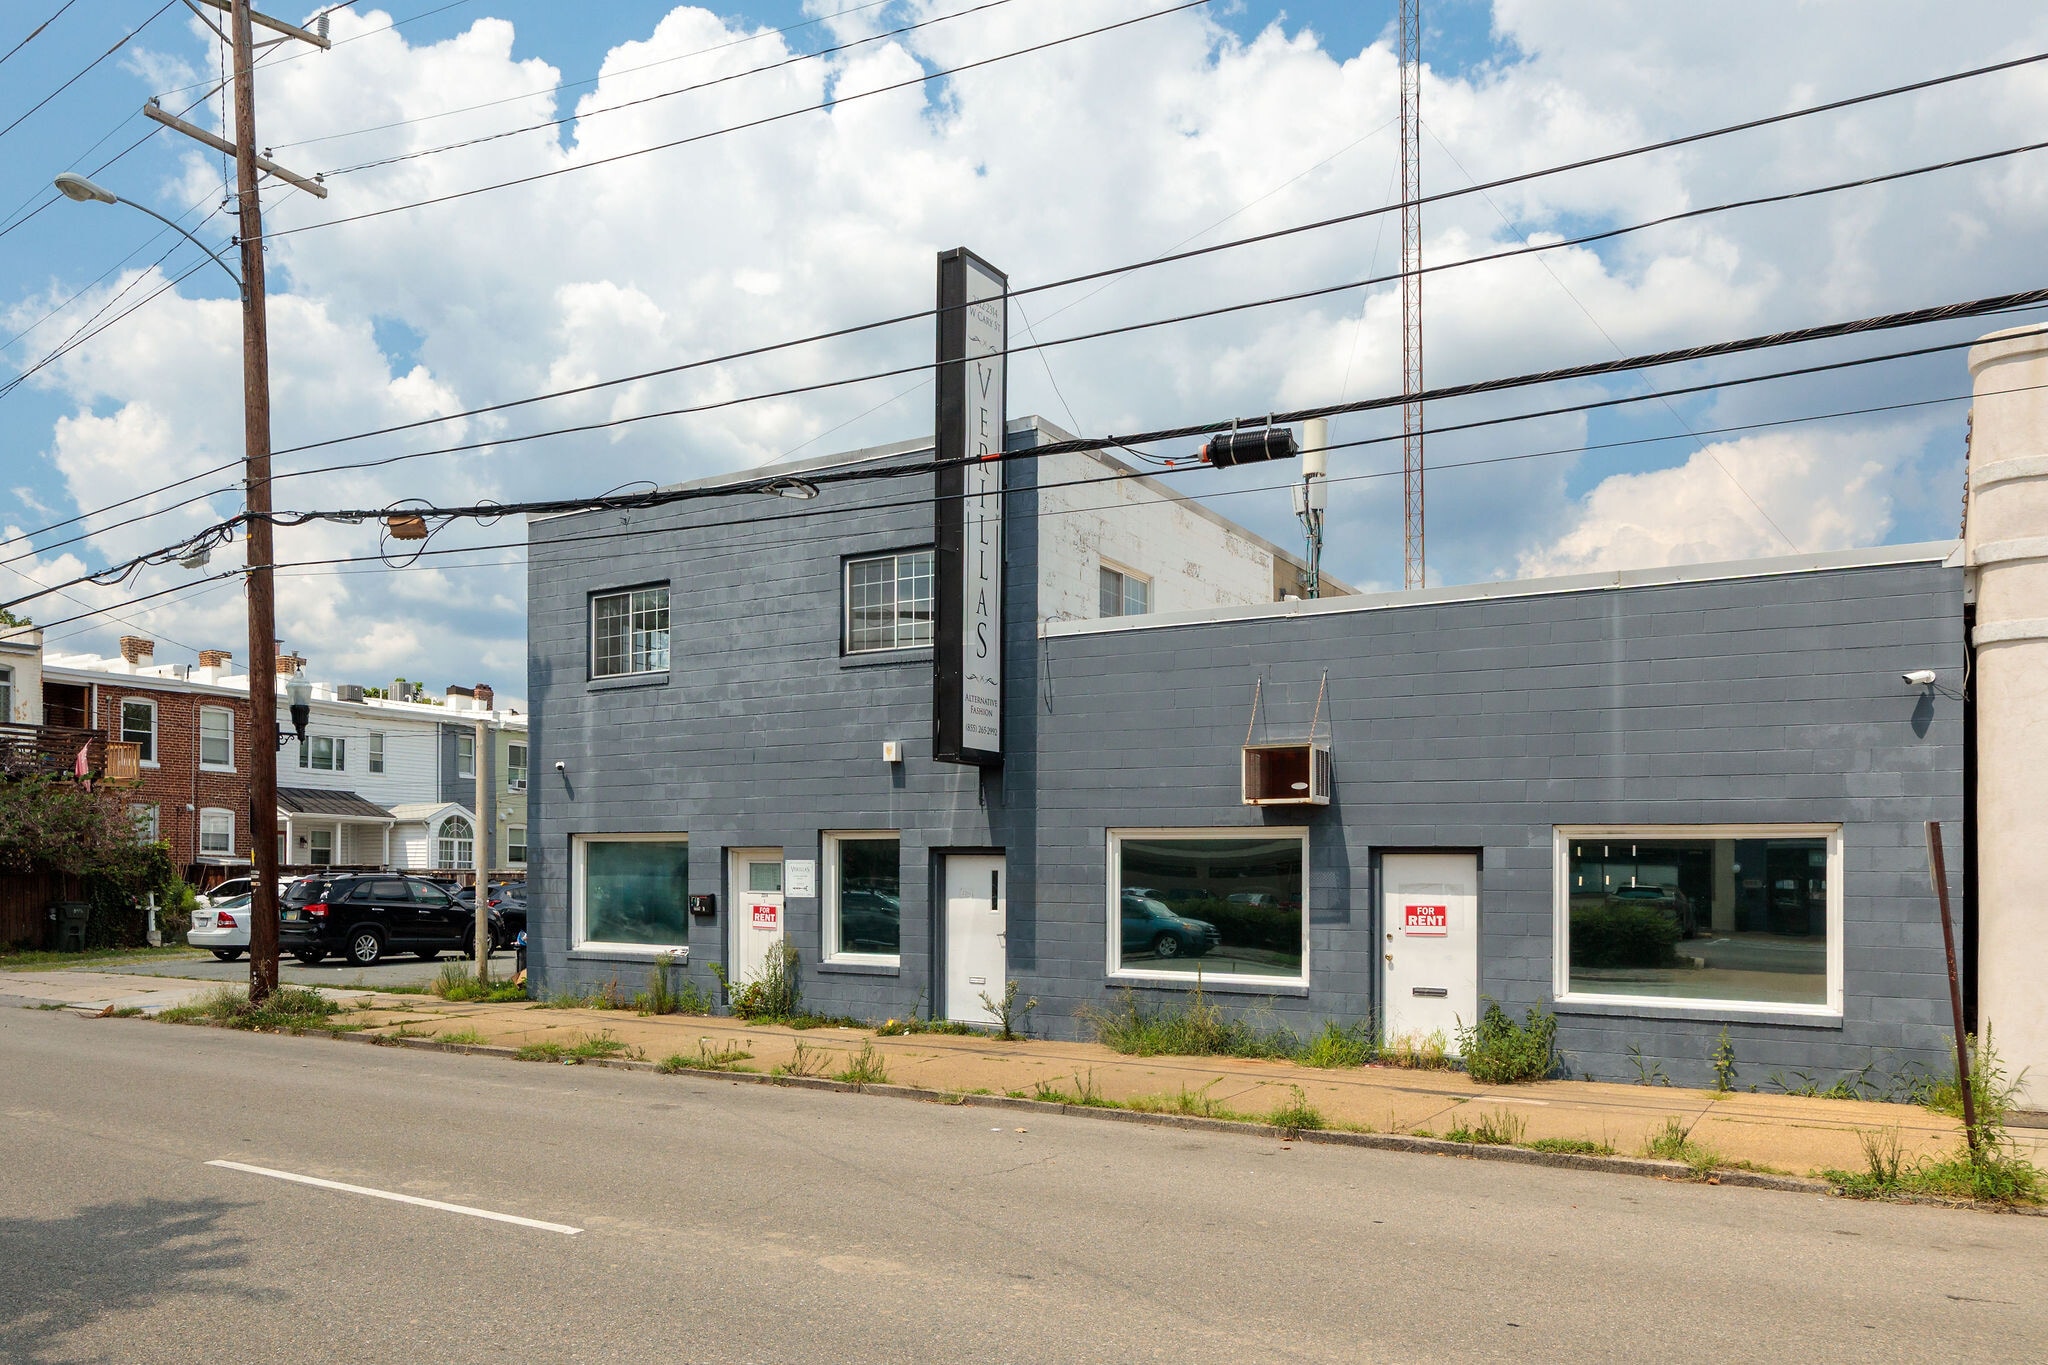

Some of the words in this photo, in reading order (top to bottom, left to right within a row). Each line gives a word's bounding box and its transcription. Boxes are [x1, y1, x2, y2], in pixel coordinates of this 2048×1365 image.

[977, 311, 993, 327] CARY
[994, 321, 1000, 332] ST
[976, 361, 992, 659] VERILLAS
[964, 693, 998, 707] ALTERNATIVE
[970, 705, 993, 717] FASHION
[1417, 907, 1435, 915] FOR
[754, 914, 776, 922] RENT
[1408, 915, 1444, 926] RENT
